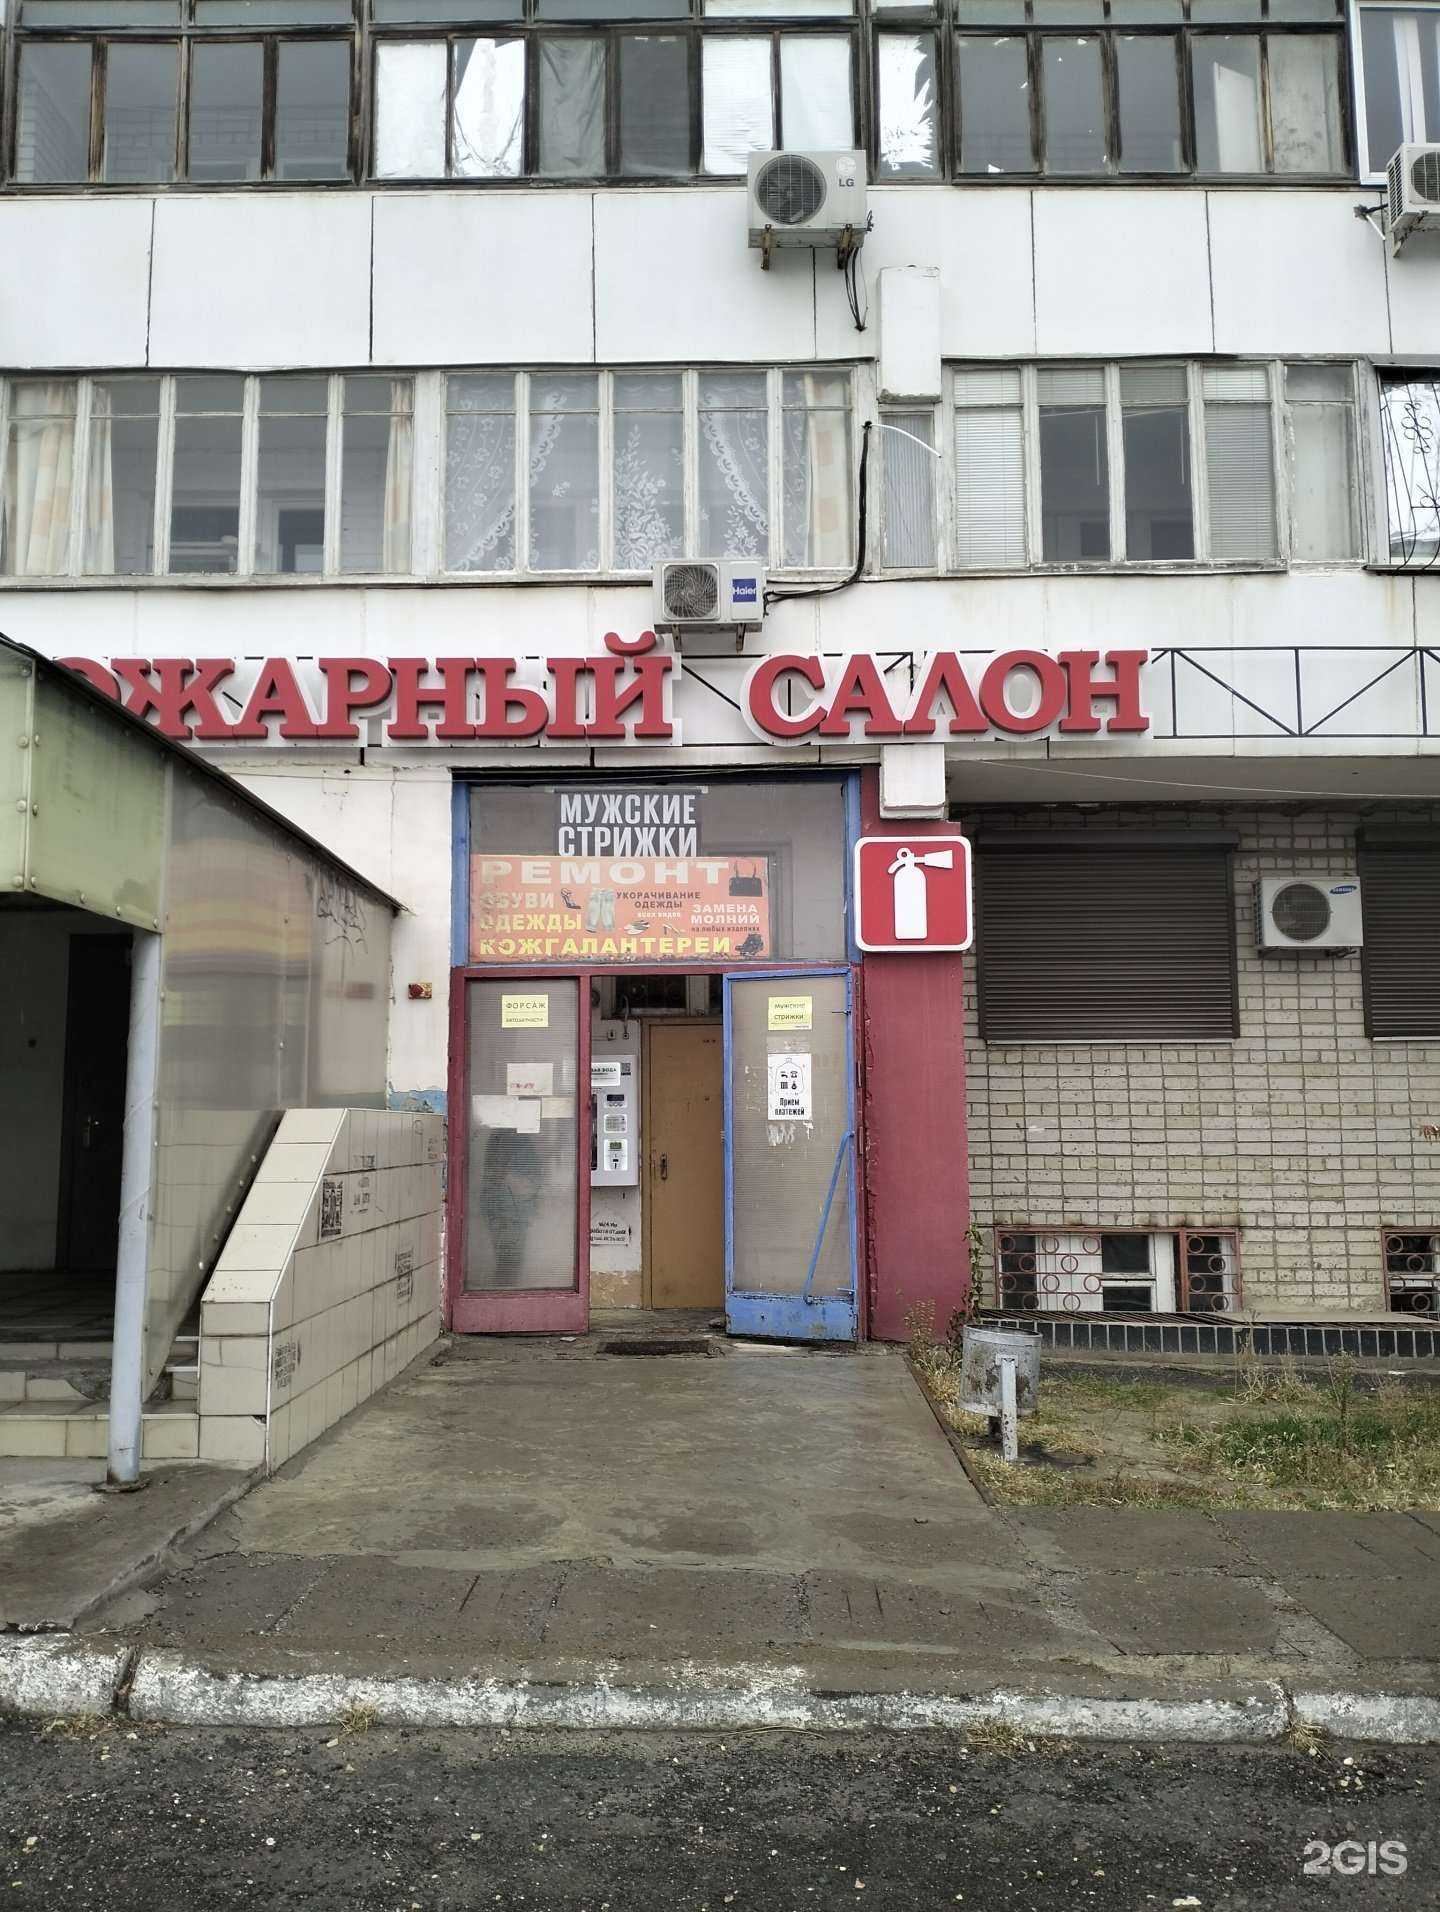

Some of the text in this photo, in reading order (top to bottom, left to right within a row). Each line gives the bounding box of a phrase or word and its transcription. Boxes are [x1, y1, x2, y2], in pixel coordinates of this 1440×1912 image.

[838, 178, 855, 187] LG
[732, 586, 756, 596] Haier
[749, 649, 1149, 739] САЛОН
[560, 793, 696, 825] МУЖСКИЕ
[558, 826, 697, 858] СТРИЖКИ
[480, 861, 730, 885] РЕМОНТ
[616, 891, 701, 900] УКОРАЧИВАНИЕ
[634, 901, 683, 909] ОДЕЖДЫ
[692, 904, 758, 913] ЗАМЕНА
[691, 913, 760, 924] МОЛНИЙ
[506, 1001, 546, 1009] ФОРСАЖ
